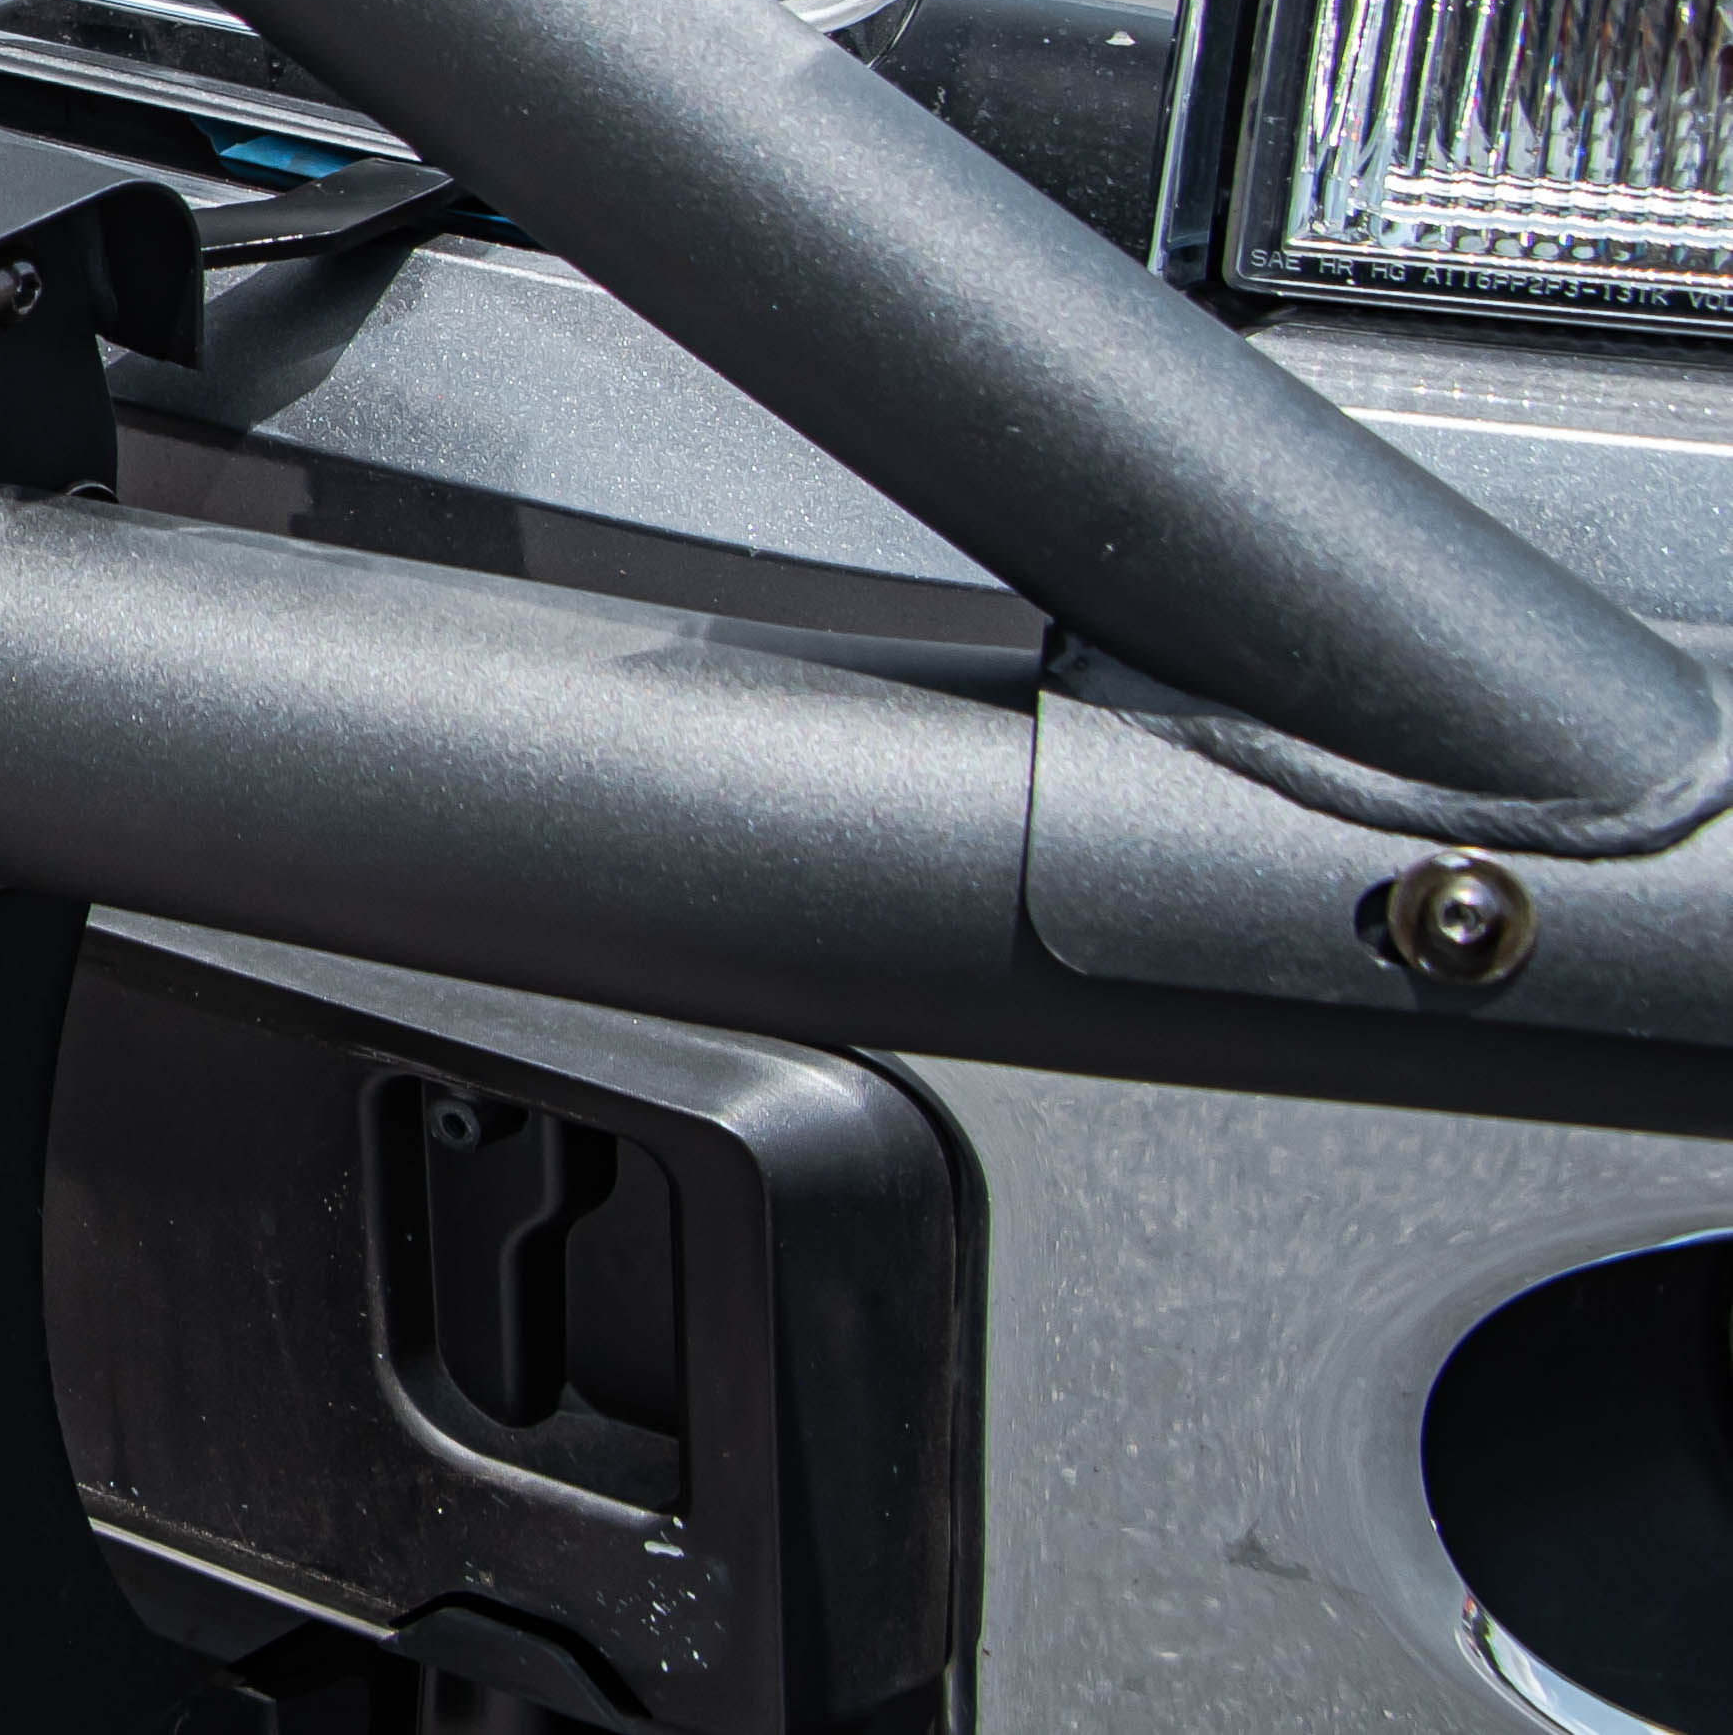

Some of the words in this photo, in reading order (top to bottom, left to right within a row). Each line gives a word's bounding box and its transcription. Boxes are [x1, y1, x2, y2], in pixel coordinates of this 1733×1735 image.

[1250, 249, 1302, 273] SAE
[1318, 256, 1354, 277] HR
[1371, 262, 1407, 282] HG
